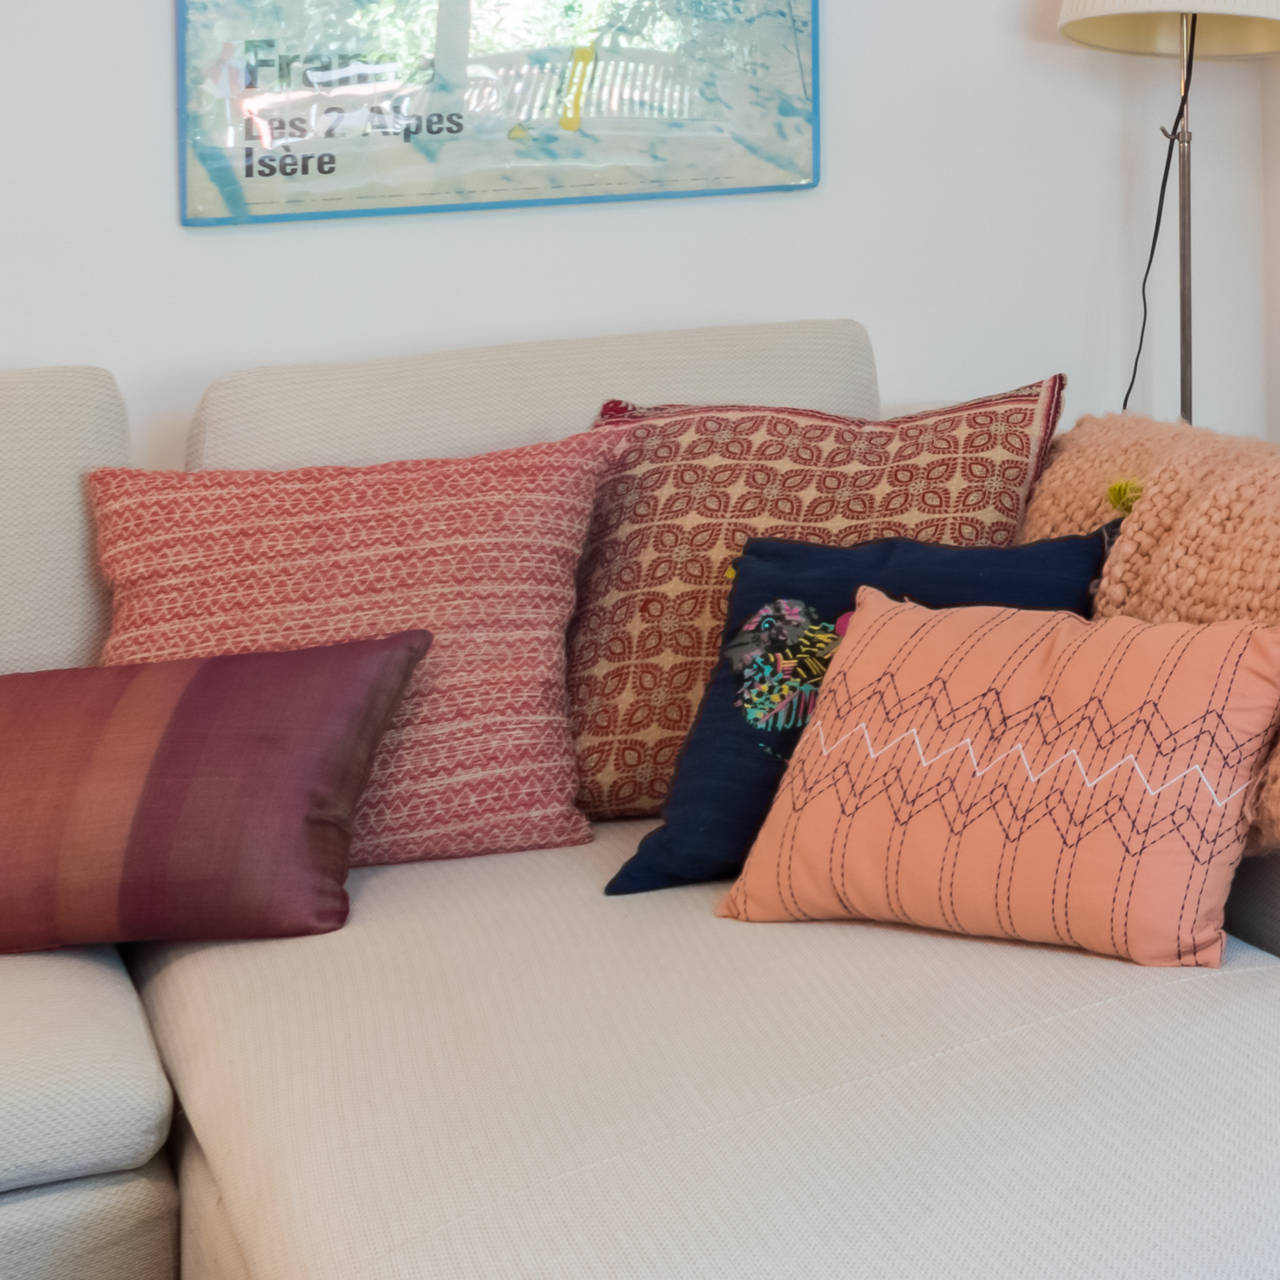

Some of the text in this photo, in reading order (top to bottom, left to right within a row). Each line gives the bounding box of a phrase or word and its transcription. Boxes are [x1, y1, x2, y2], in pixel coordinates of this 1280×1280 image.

[245, 39, 435, 89] Frane
[325, 106, 346, 138] 2
[361, 104, 464, 143] Alpes
[244, 143, 337, 178] Isère
